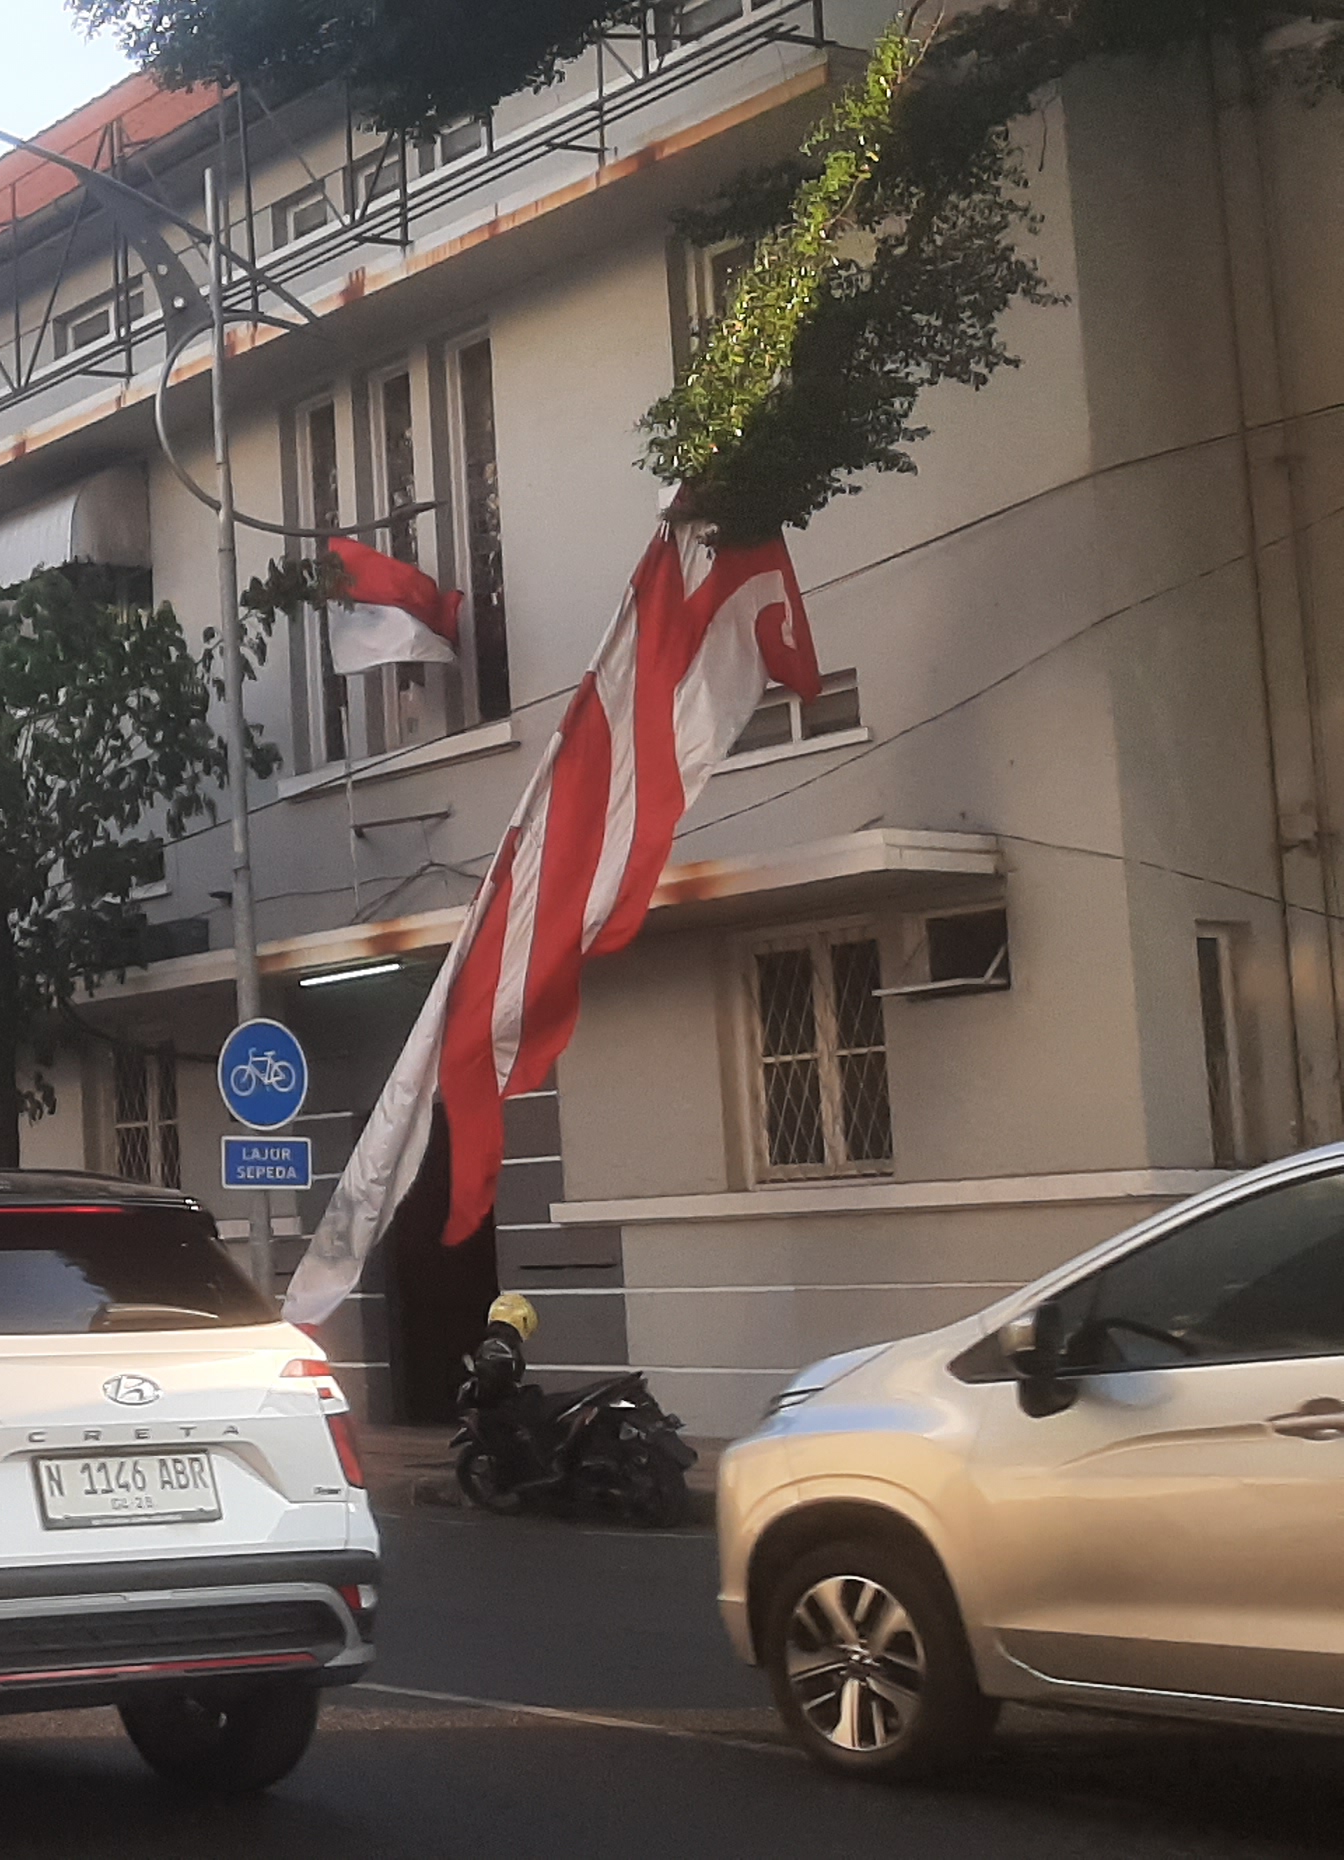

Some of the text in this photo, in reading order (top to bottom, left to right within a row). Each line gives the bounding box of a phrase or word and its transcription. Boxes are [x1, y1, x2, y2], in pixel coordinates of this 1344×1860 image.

[242, 1147, 291, 1161] LAJUR
[236, 1165, 297, 1179] SEPEDA
[28, 1426, 240, 1442] CRETA
[44, 1457, 210, 1497] N 1146 ABR
